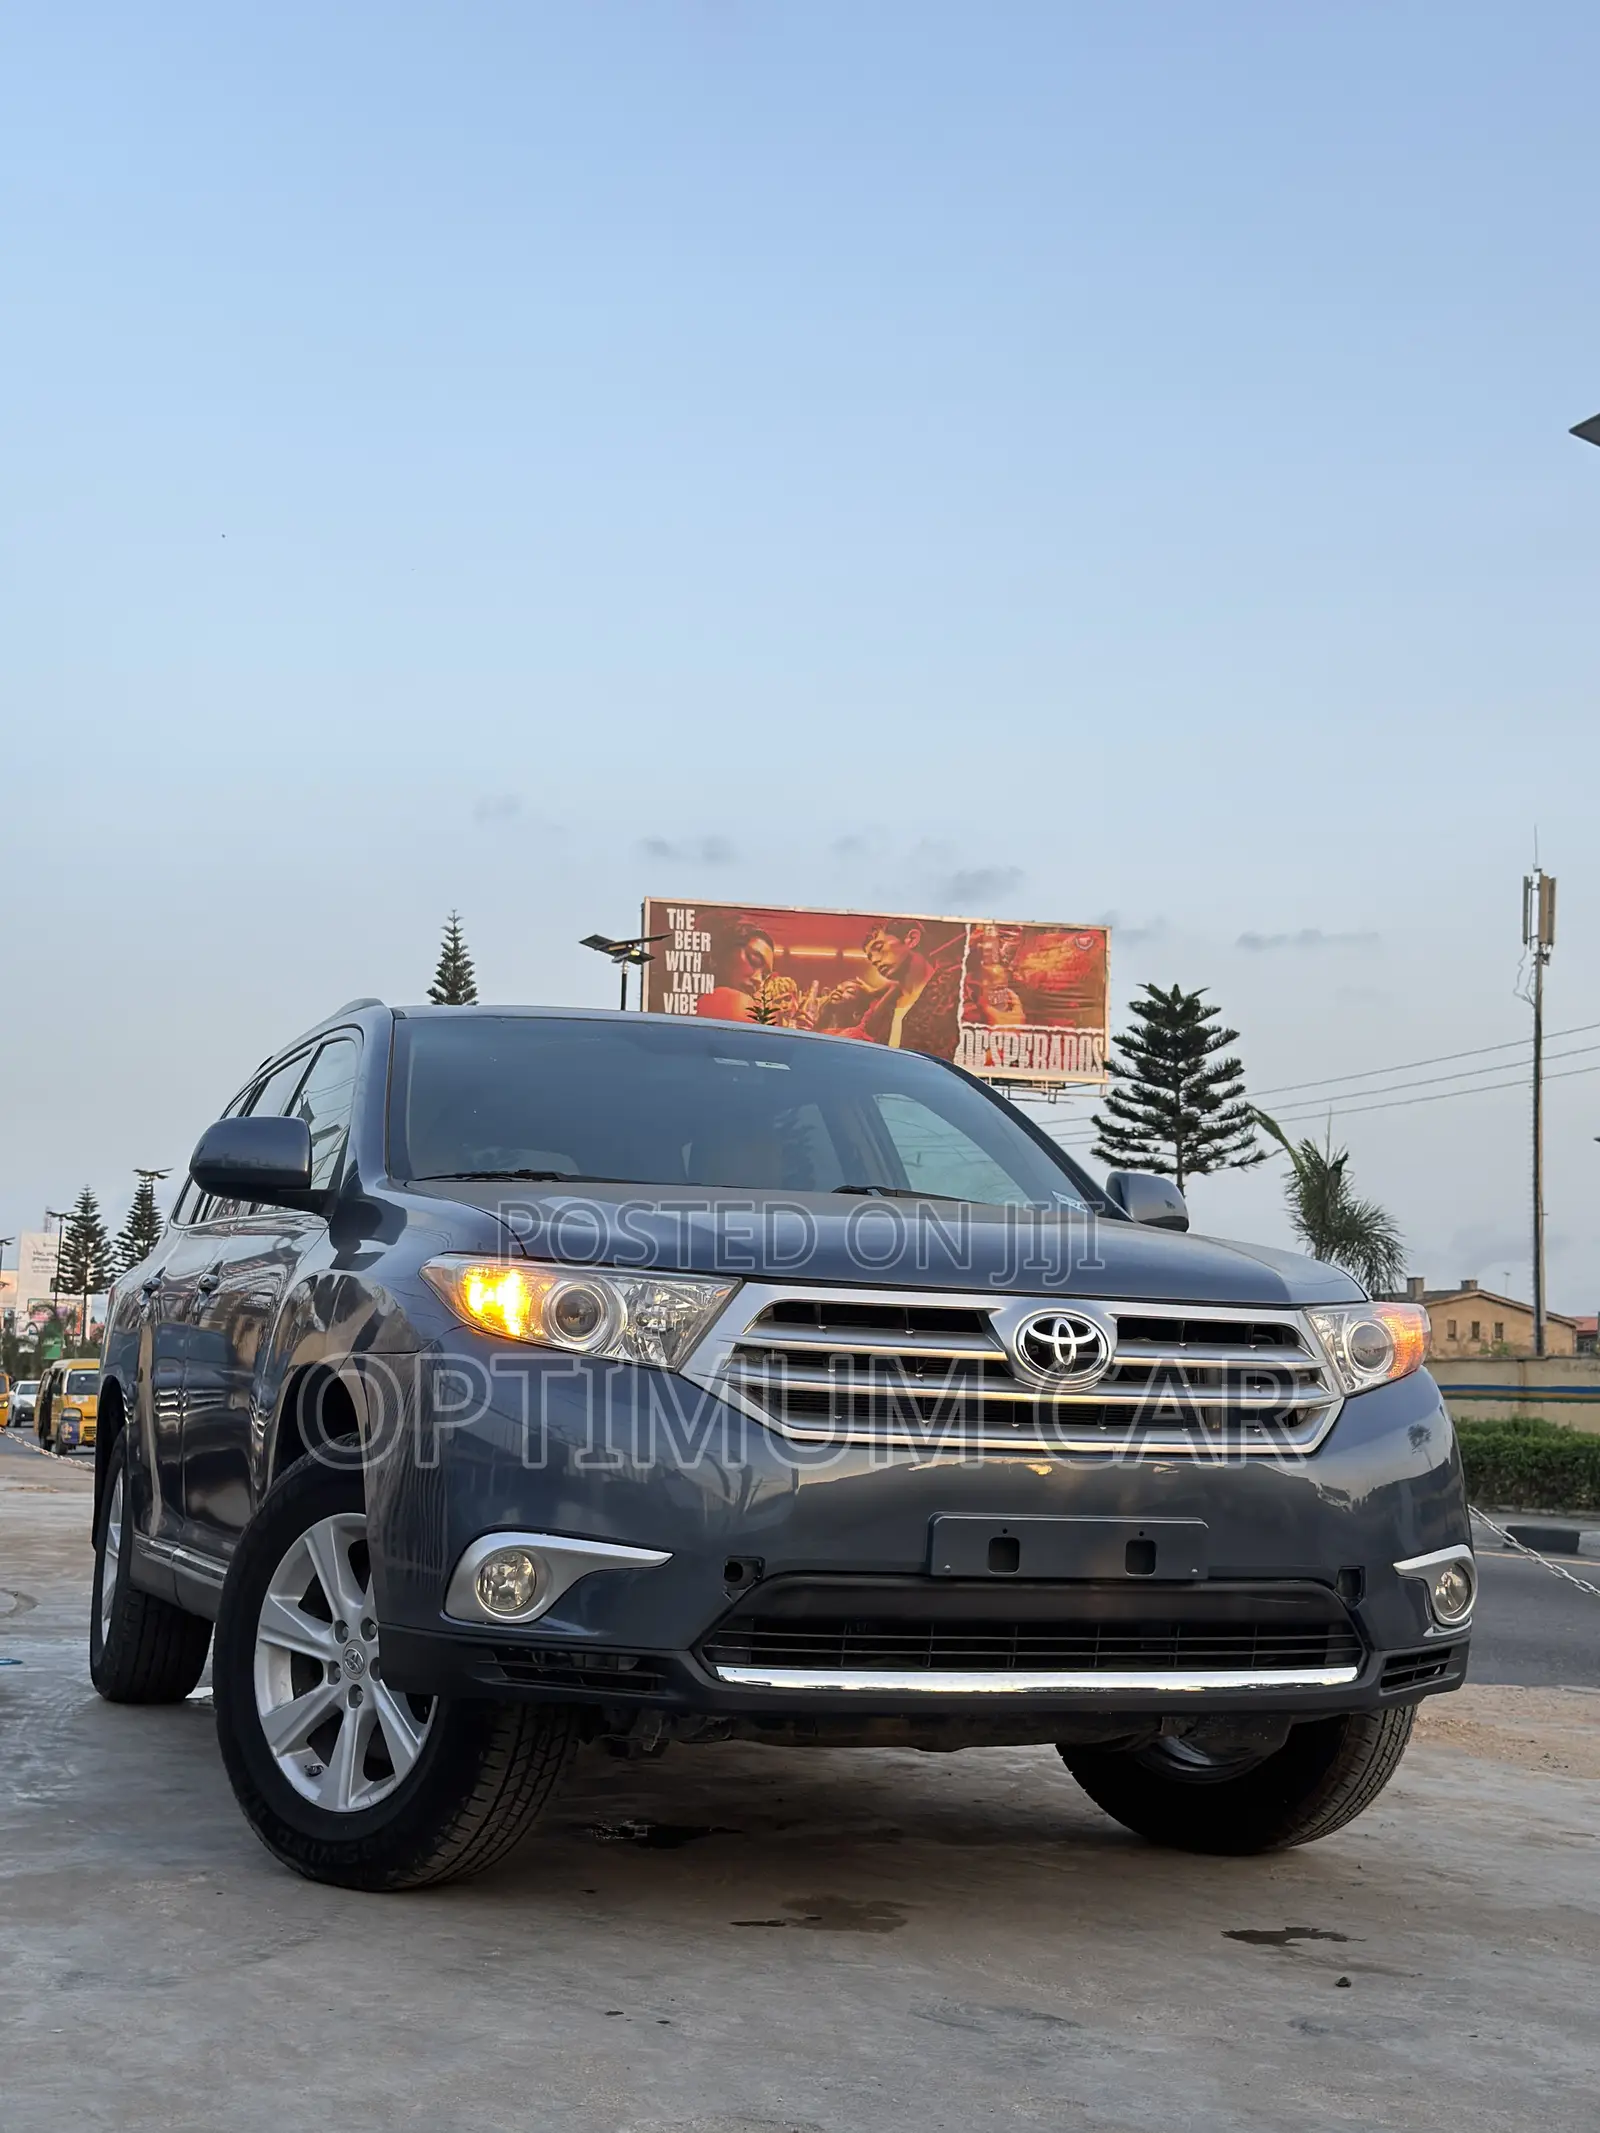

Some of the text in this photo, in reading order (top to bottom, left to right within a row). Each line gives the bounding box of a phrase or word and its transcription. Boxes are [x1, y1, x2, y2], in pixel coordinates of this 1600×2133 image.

[666, 907, 696, 930] THE
[674, 930, 711, 952] BEER
[665, 950, 702, 972] WITH
[672, 972, 715, 994] LATIN
[663, 992, 699, 1015] VIBE
[956, 1028, 1105, 1073] DESPERADOS
